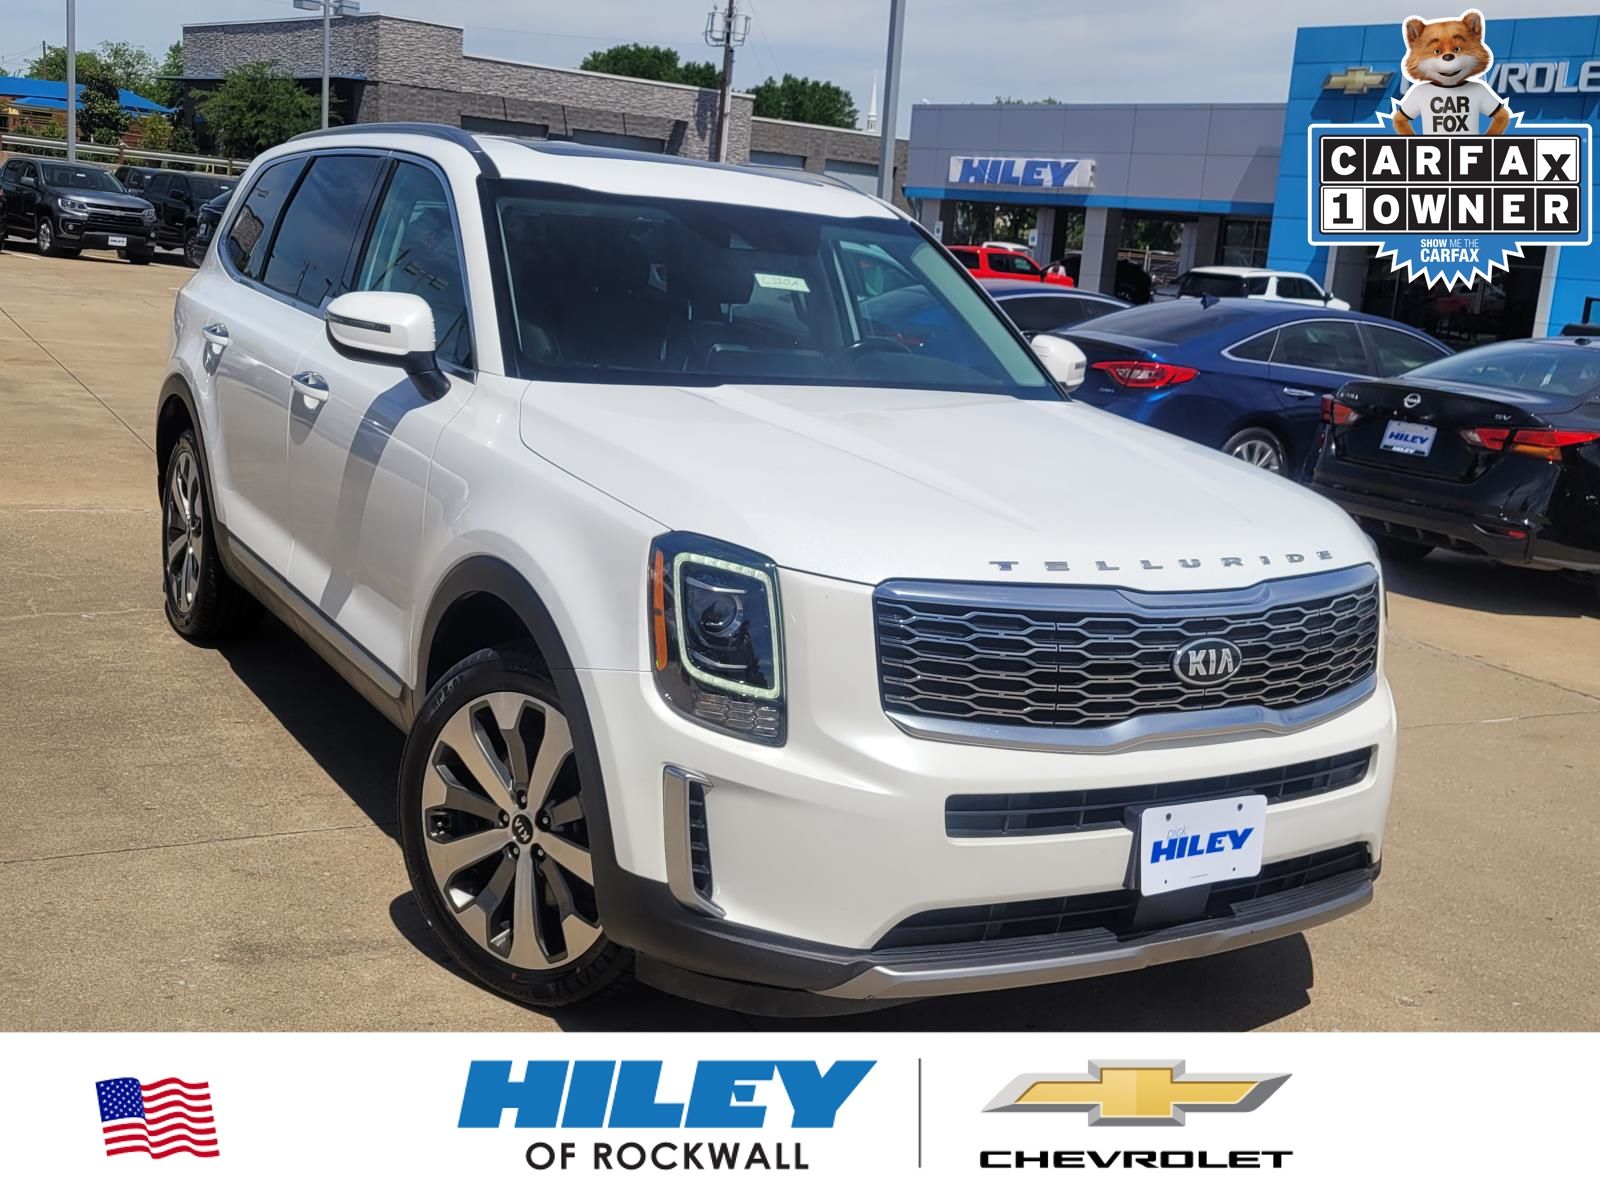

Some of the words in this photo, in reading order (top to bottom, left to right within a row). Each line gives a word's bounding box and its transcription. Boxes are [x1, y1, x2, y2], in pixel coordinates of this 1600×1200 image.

[959, 159, 1079, 187] HILEY
[1389, 431, 1429, 444] HILEY
[989, 550, 1334, 572] TELLURIDE
[1188, 647, 1234, 677] KIA
[514, 817, 530, 842] KIA
[1150, 827, 1255, 864] HILEY
